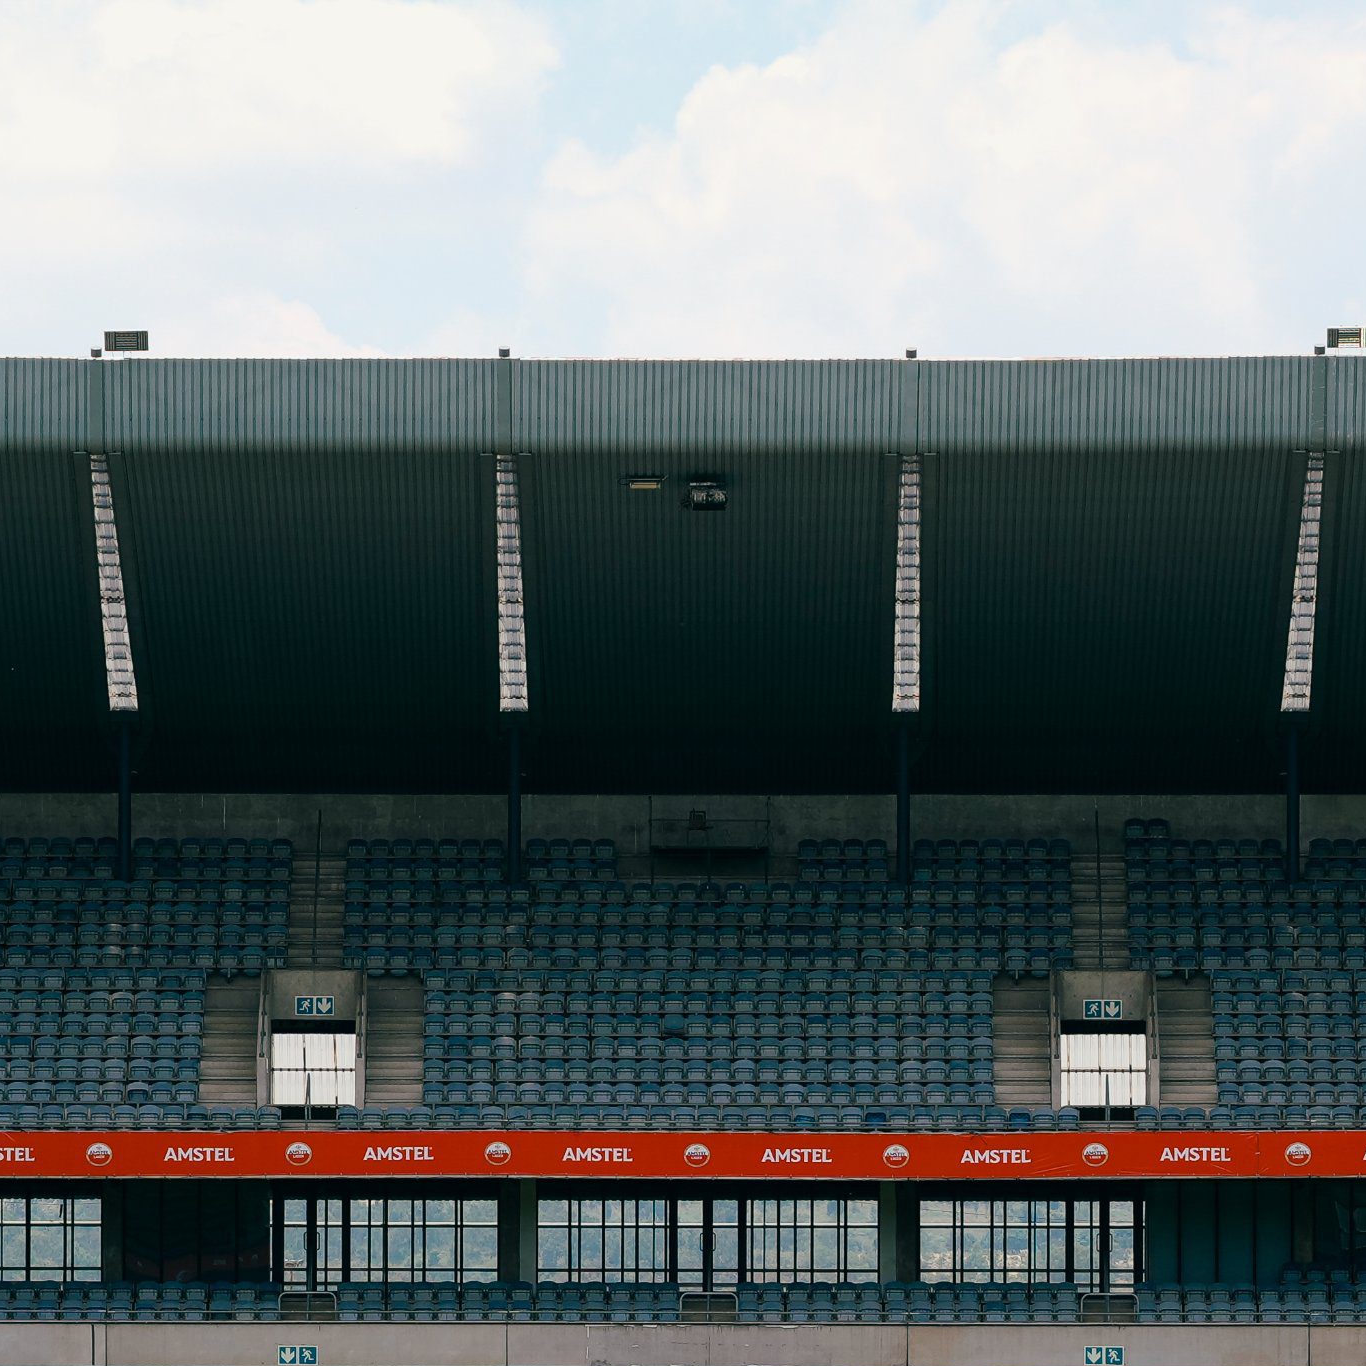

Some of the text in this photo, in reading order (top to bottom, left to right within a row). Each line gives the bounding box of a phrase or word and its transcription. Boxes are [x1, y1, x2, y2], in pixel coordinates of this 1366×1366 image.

[164, 1148, 235, 1161] AMSTEL
[364, 1147, 434, 1160] AMSTEL
[563, 1148, 633, 1161] AMSTEL
[762, 1149, 833, 1162] AMSTEL
[961, 1150, 1032, 1163] AMSTEL
[1161, 1148, 1231, 1161] AMSTEL
